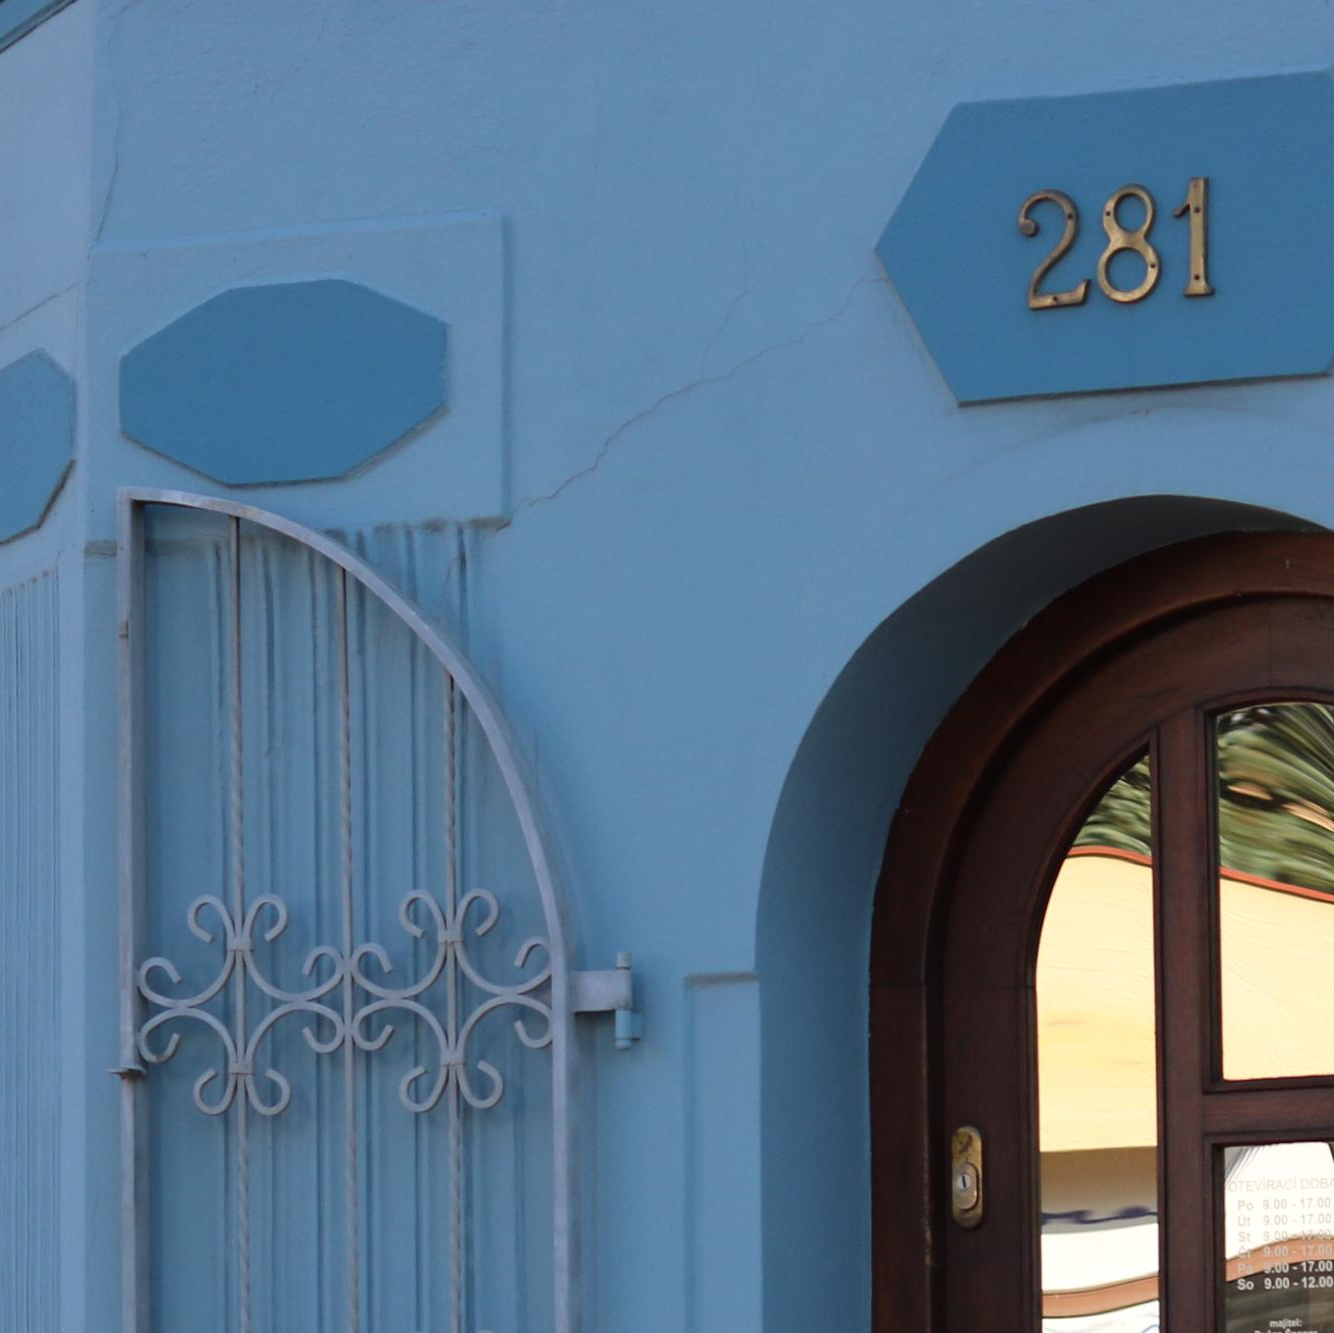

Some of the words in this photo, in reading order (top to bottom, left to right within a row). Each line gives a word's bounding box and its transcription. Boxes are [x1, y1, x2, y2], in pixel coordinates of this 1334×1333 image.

[1018, 176, 1216, 311] 281
[1228, 1177, 1296, 1192] OTEVÍRACÍ
[1237, 1200, 1253, 1210] Po
[1263, 1200, 1287, 1210] 9.00
[1301, 1198, 1331, 1208] 17.00
[1263, 1215, 1288, 1226] 9.00
[1301, 1214, 1331, 1224] 17.00
[1238, 1232, 1250, 1242] St
[1263, 1246, 1288, 1257] 9.00
[1302, 1245, 1332, 1256] 17.00
[1264, 1263, 1289, 1274] 9.00
[1302, 1261, 1333, 1272] 17.00
[1237, 1279, 1254, 1290] So
[1264, 1278, 1289, 1289] 9.00
[1302, 1276, 1333, 1288] 12.00
[1269, 1318, 1302, 1329] majitel:
